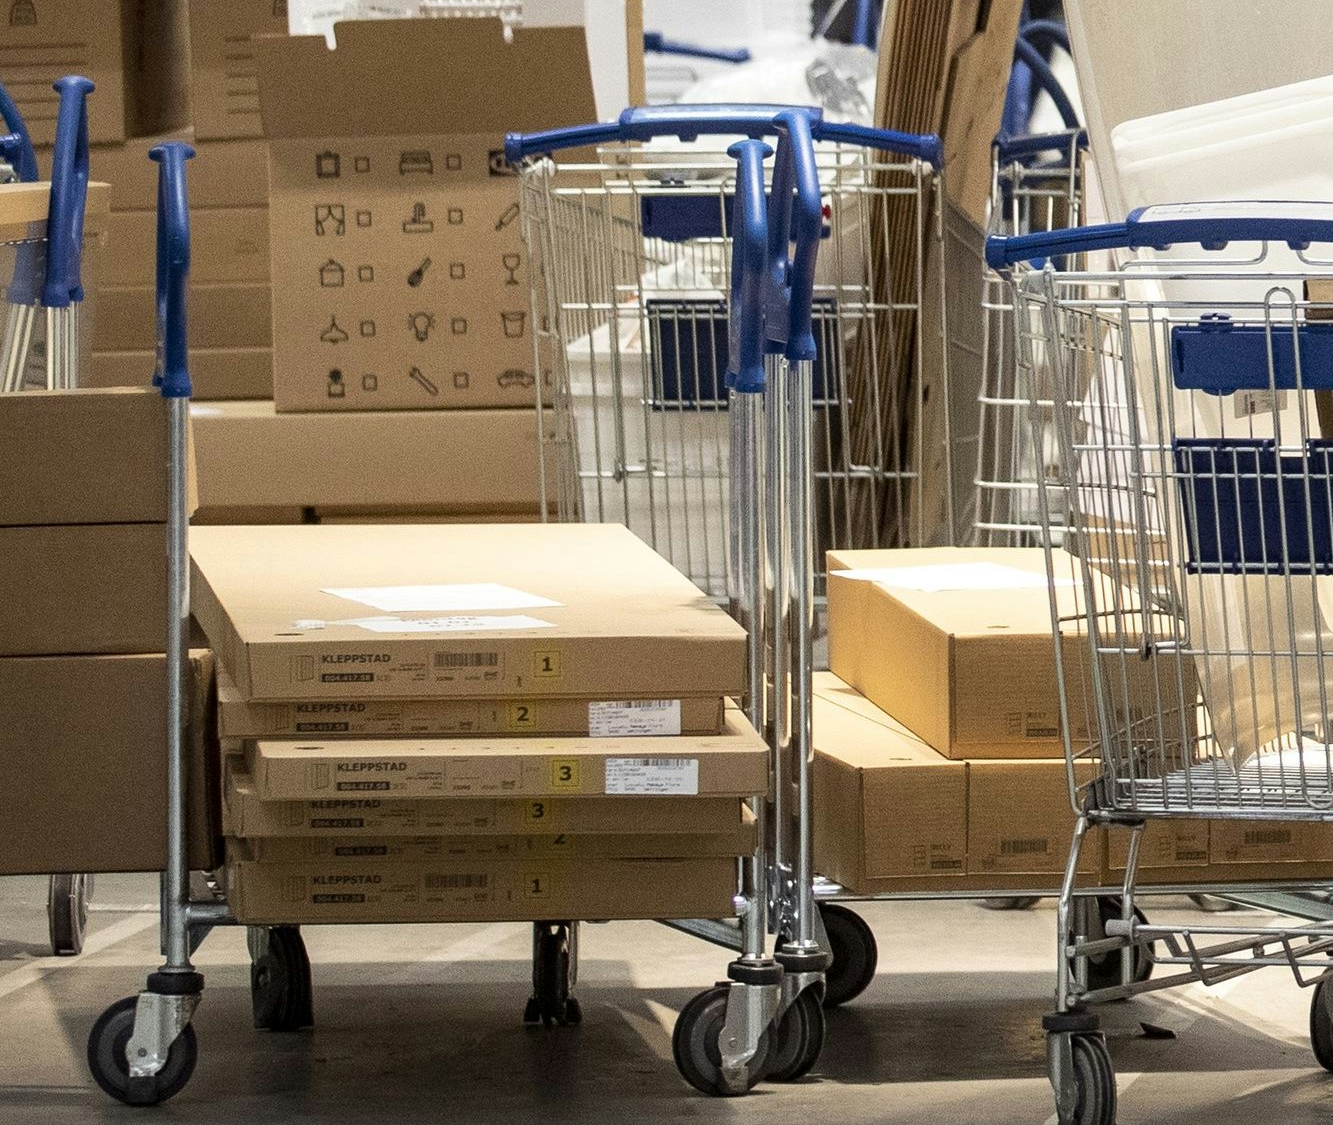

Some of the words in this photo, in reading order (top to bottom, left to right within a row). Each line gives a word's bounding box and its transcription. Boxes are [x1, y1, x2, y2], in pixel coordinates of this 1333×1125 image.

[322, 653, 391, 664] KLEPPSTAD
[542, 656, 553, 672] 1
[296, 703, 366, 713] KLEPPSTAD
[517, 706, 529, 722] 2
[337, 762, 408, 772] KLEPPSTAD
[559, 765, 572, 781] 3
[311, 799, 381, 809] KLEPPSTAD
[532, 802, 544, 818] 3
[313, 875, 381, 885] KLEPPSTAD
[531, 878, 543, 893] 1
